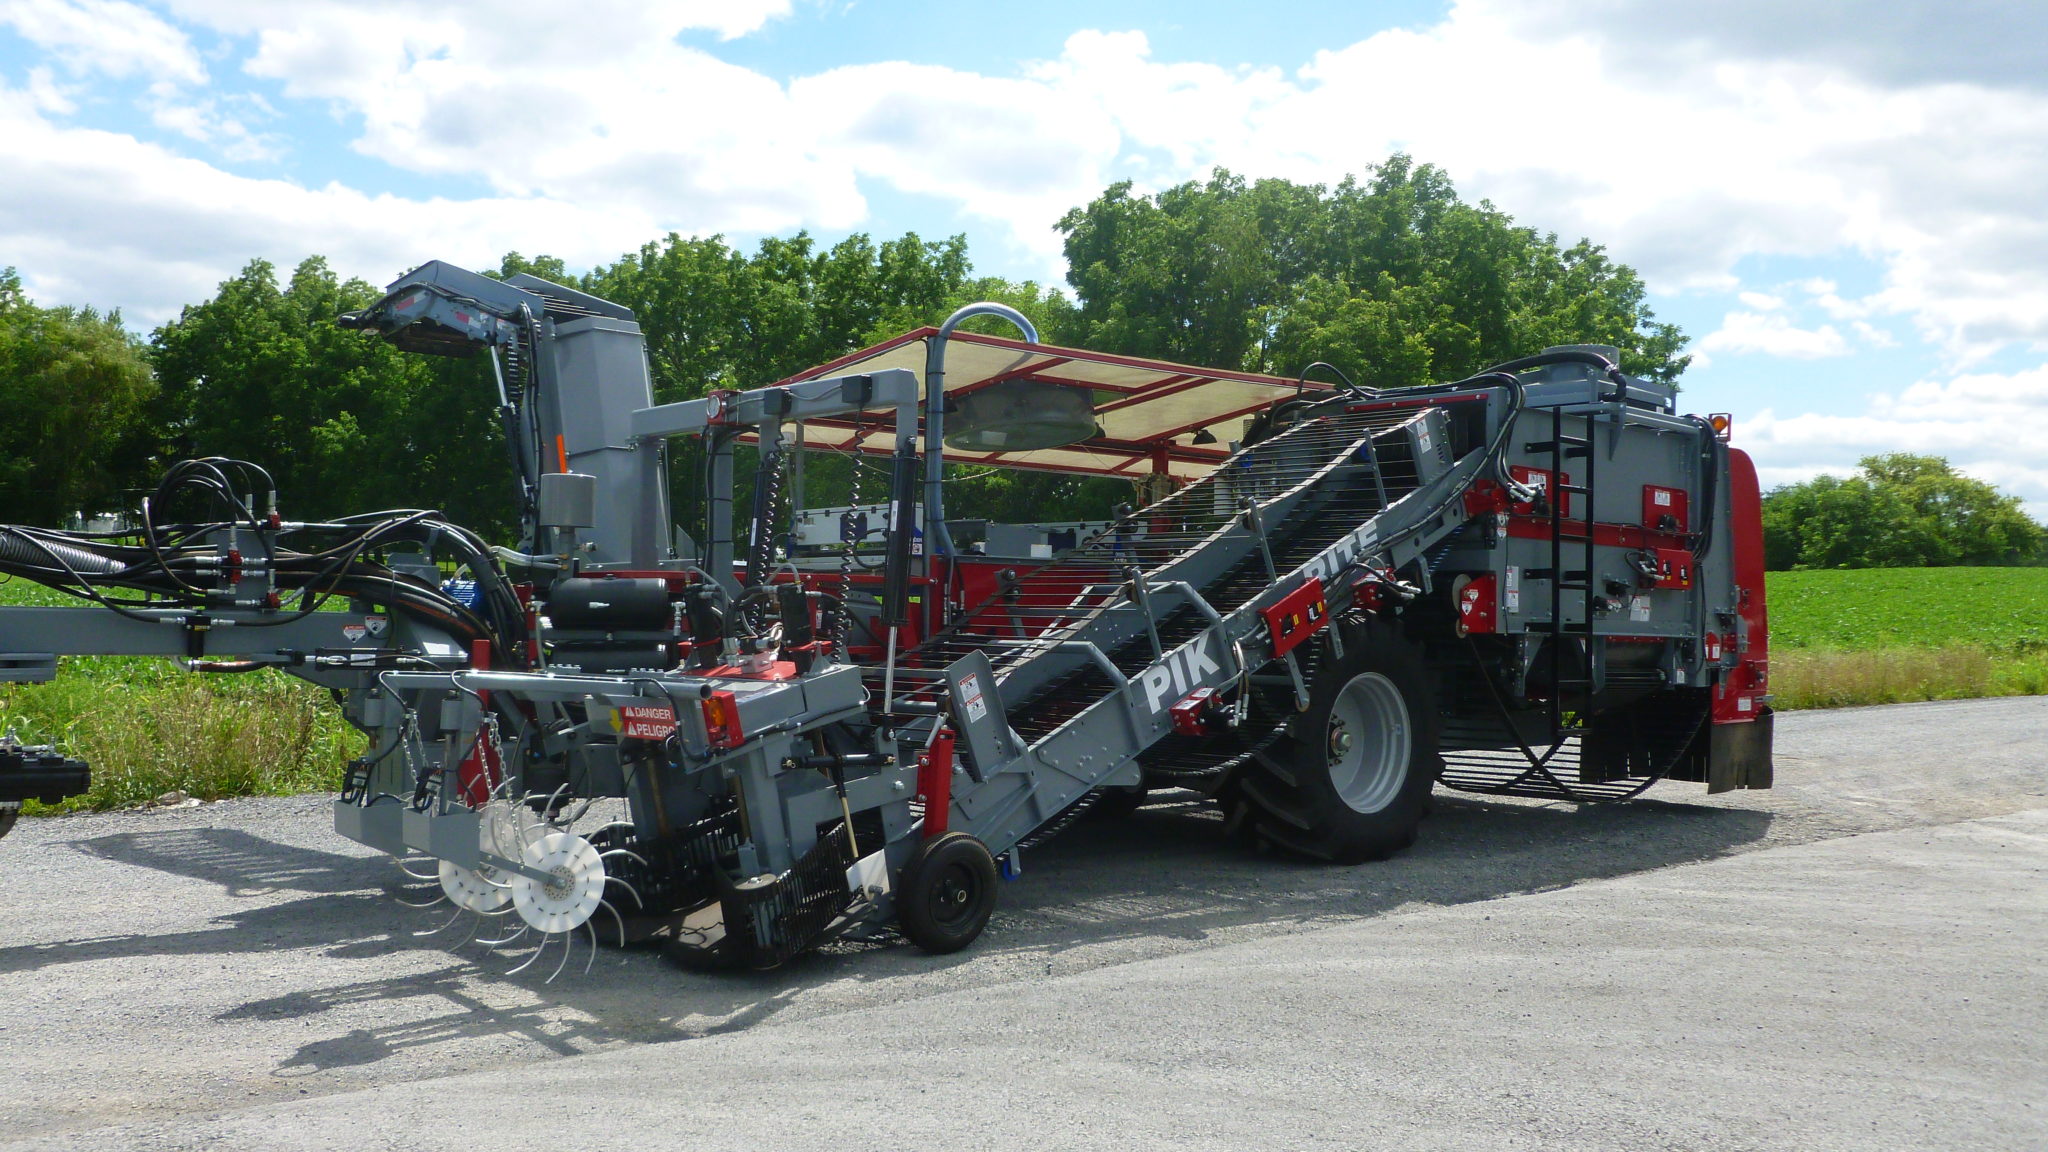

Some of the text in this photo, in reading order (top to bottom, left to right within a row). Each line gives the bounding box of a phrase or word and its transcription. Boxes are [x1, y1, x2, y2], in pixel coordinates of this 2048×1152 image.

[1142, 520, 1378, 714] PIK RITE
[635, 707, 672, 719] DANGER
